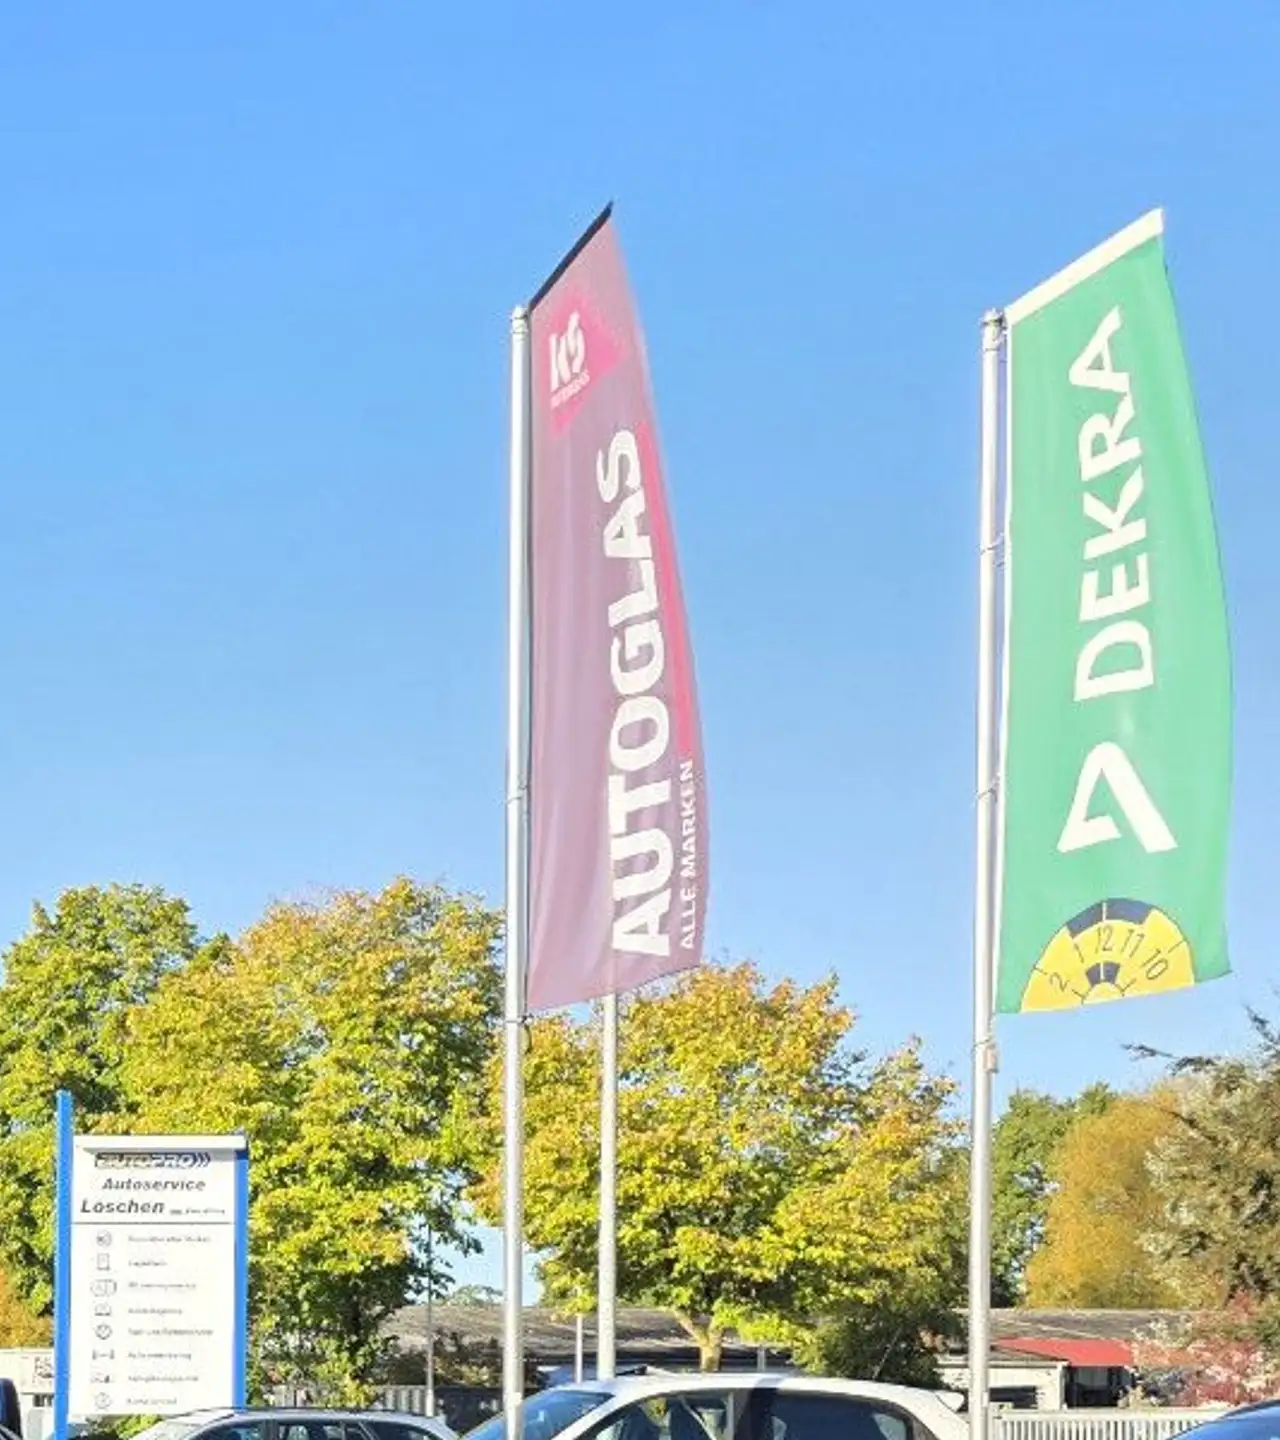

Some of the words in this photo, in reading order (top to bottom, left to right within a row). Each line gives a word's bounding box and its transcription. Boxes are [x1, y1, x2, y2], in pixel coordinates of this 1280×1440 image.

[1069, 306, 1155, 702] DEKRA
[596, 429, 675, 956] AUTOGLAS
[678, 758, 695, 881] MARKEN
[678, 885, 694, 950] ALLE
[1049, 972, 1070, 993] 2
[1095, 925, 1114, 954] 12
[1120, 928, 1146, 959] 11
[1142, 948, 1169, 981] 10
[101, 1177, 206, 1192] Autoservice
